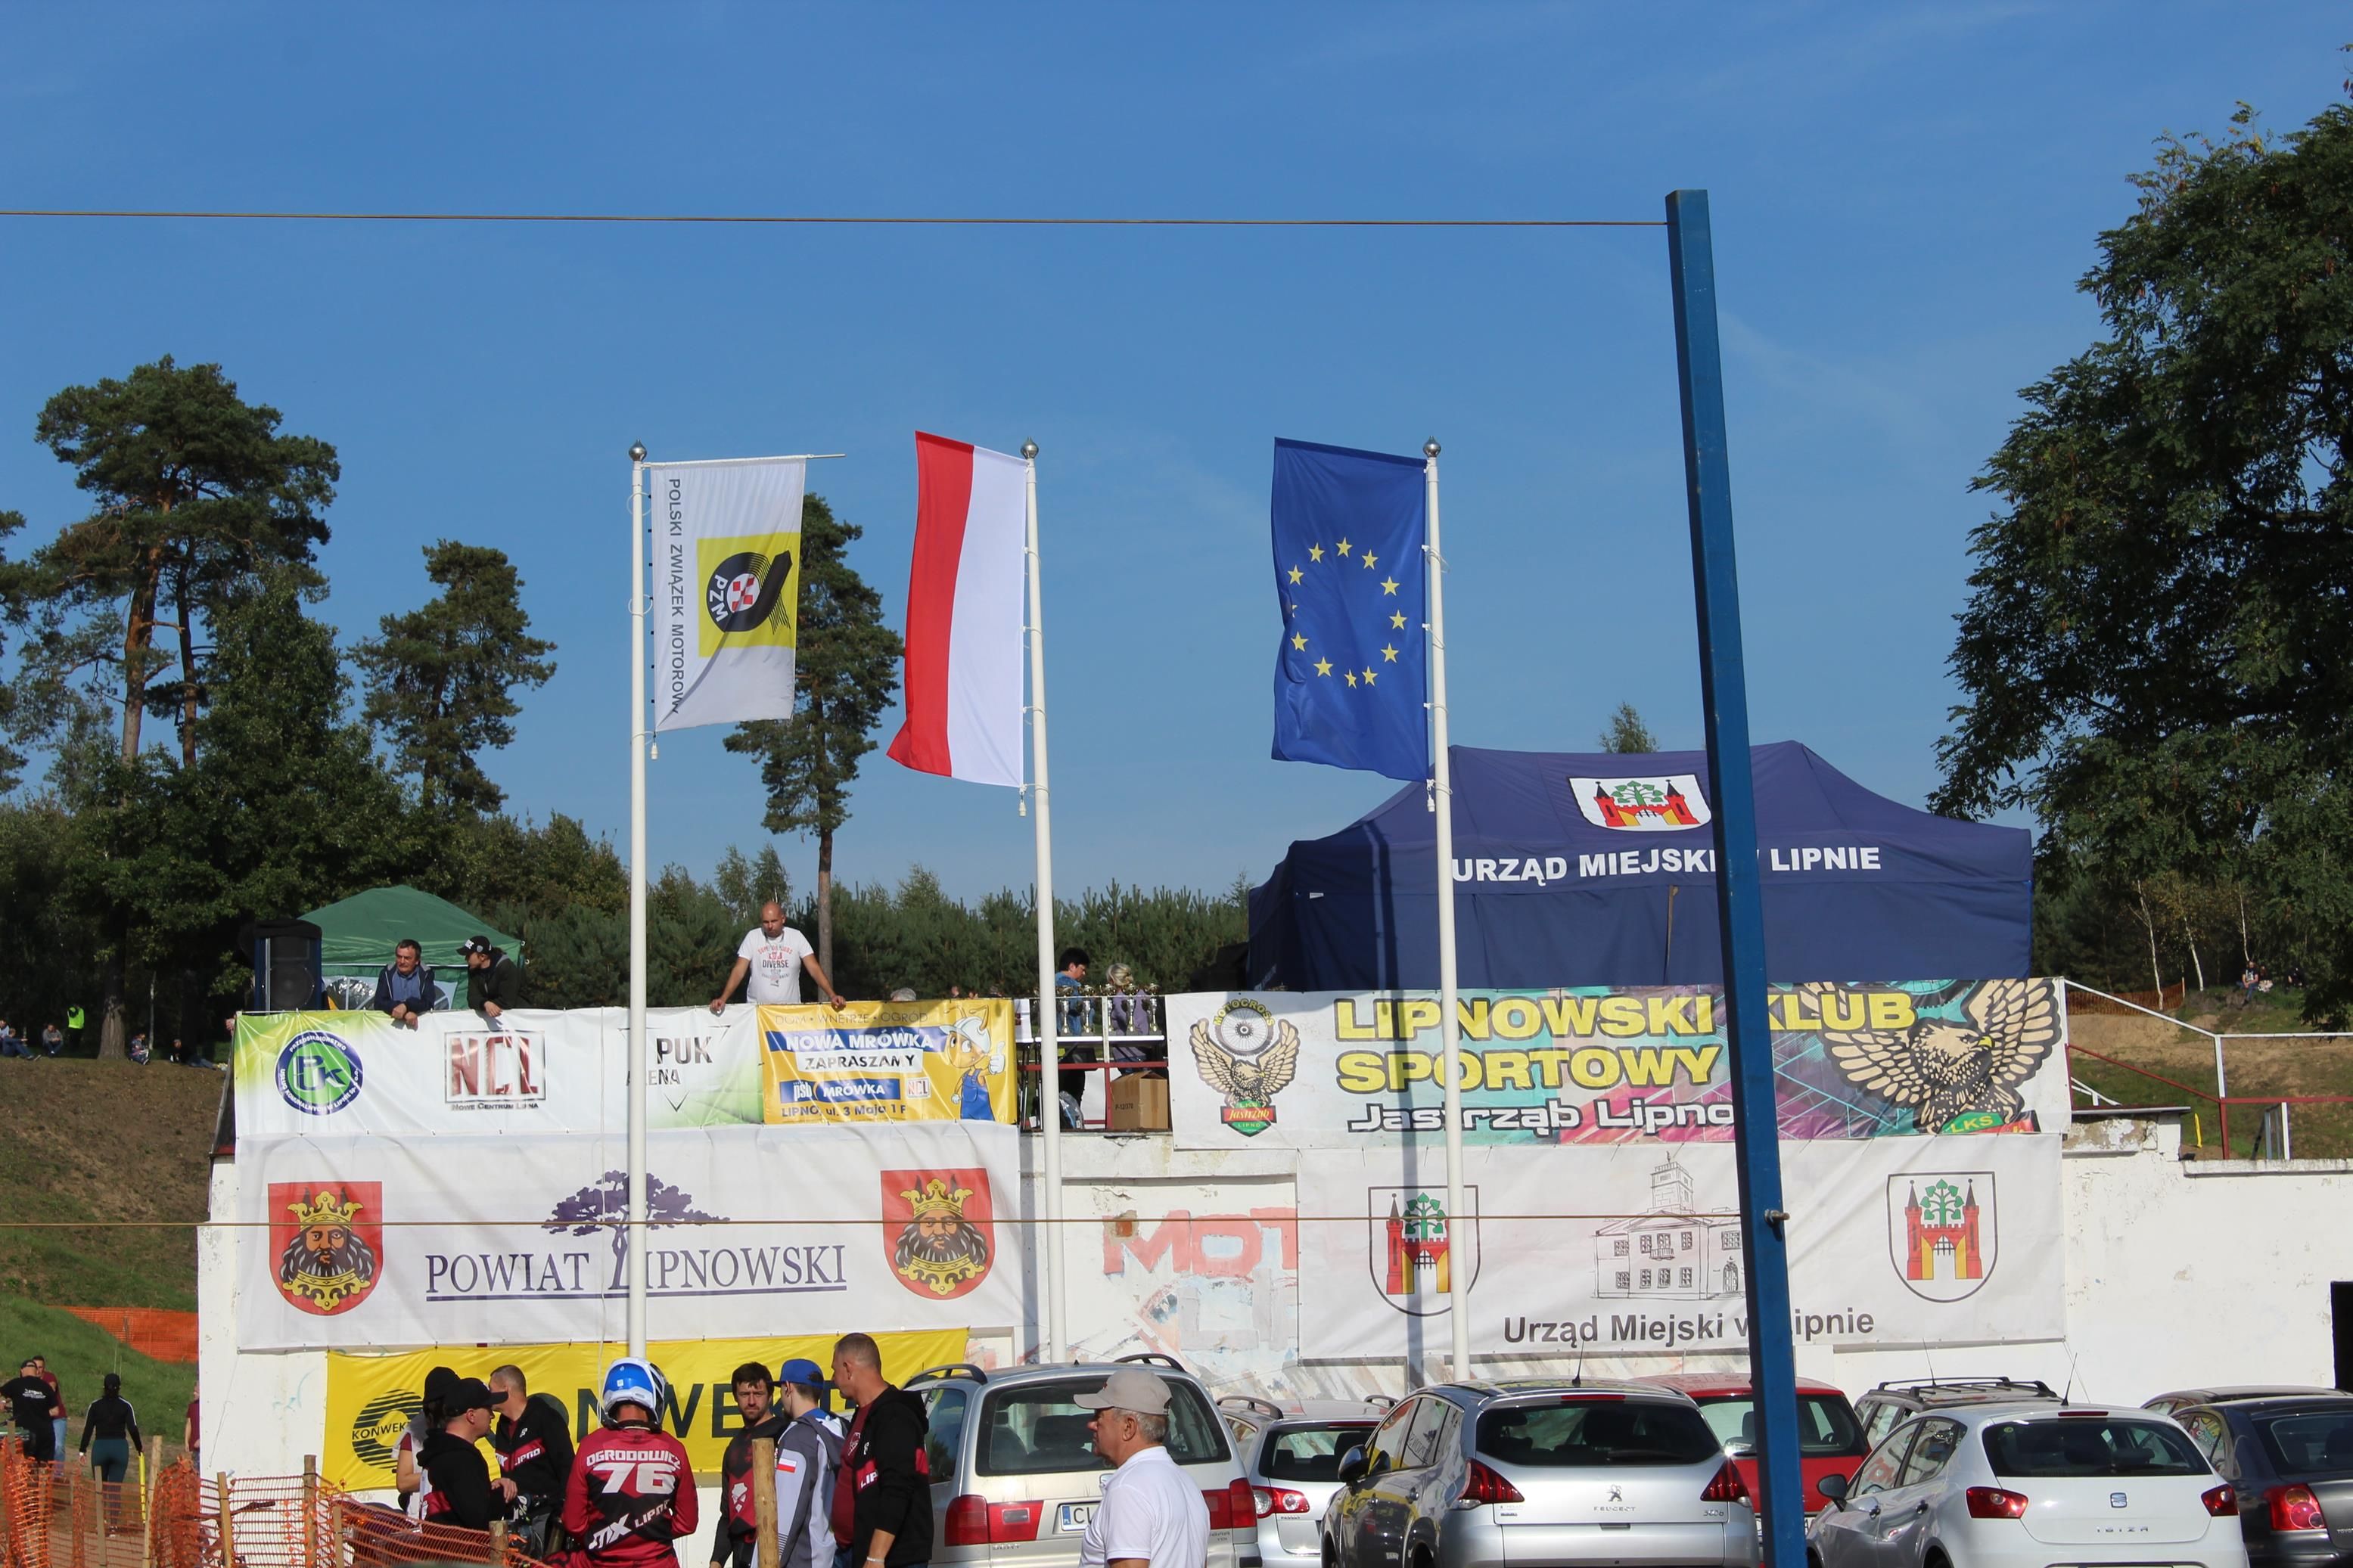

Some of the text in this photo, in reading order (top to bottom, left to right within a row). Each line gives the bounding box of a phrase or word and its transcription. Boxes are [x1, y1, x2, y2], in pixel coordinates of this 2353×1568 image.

[668, 479, 682, 536] POLSKI
[669, 544, 684, 616] ZWIĄZEK
[709, 574, 729, 623] PZM
[1452, 856, 1568, 886] URZĄD
[1770, 846, 1881, 871] LIPNIE
[763, 959, 789, 968] DIVERSE
[775, 1010, 928, 1024] DOM WNĘTRZE OGRÓD
[1214, 998, 1275, 1026] MOTOCROSS
[1335, 995, 1715, 1042] LIPNOWSKI
[657, 1036, 713, 1064] PUK
[786, 1029, 934, 1051] NOWA MRÓWKA
[451, 1036, 539, 1096] NCL
[626, 1069, 681, 1086] ENA
[805, 1054, 915, 1070] ZAPRASZAMY
[1336, 1044, 1722, 1094] SPORTOWY
[823, 1082, 885, 1098] MRÓWKA
[908, 1079, 928, 1094] NCL
[844, 1106, 851, 1116] 3
[855, 1104, 886, 1117] Maja
[892, 1104, 897, 1113] 1
[1347, 1098, 1734, 1138] Jasrząb Lipno
[1950, 1116, 1994, 1133] LKS
[425, 1253, 590, 1293] POWIAT
[1504, 1315, 1598, 1349] Urząd
[1611, 1312, 1724, 1347] Miejski
[1795, 1307, 1875, 1342] ipnie
[586, 1449, 681, 1470] OGRODOWICZ
[592, 1461, 676, 1495] 76
[589, 1513, 633, 1550] MX
